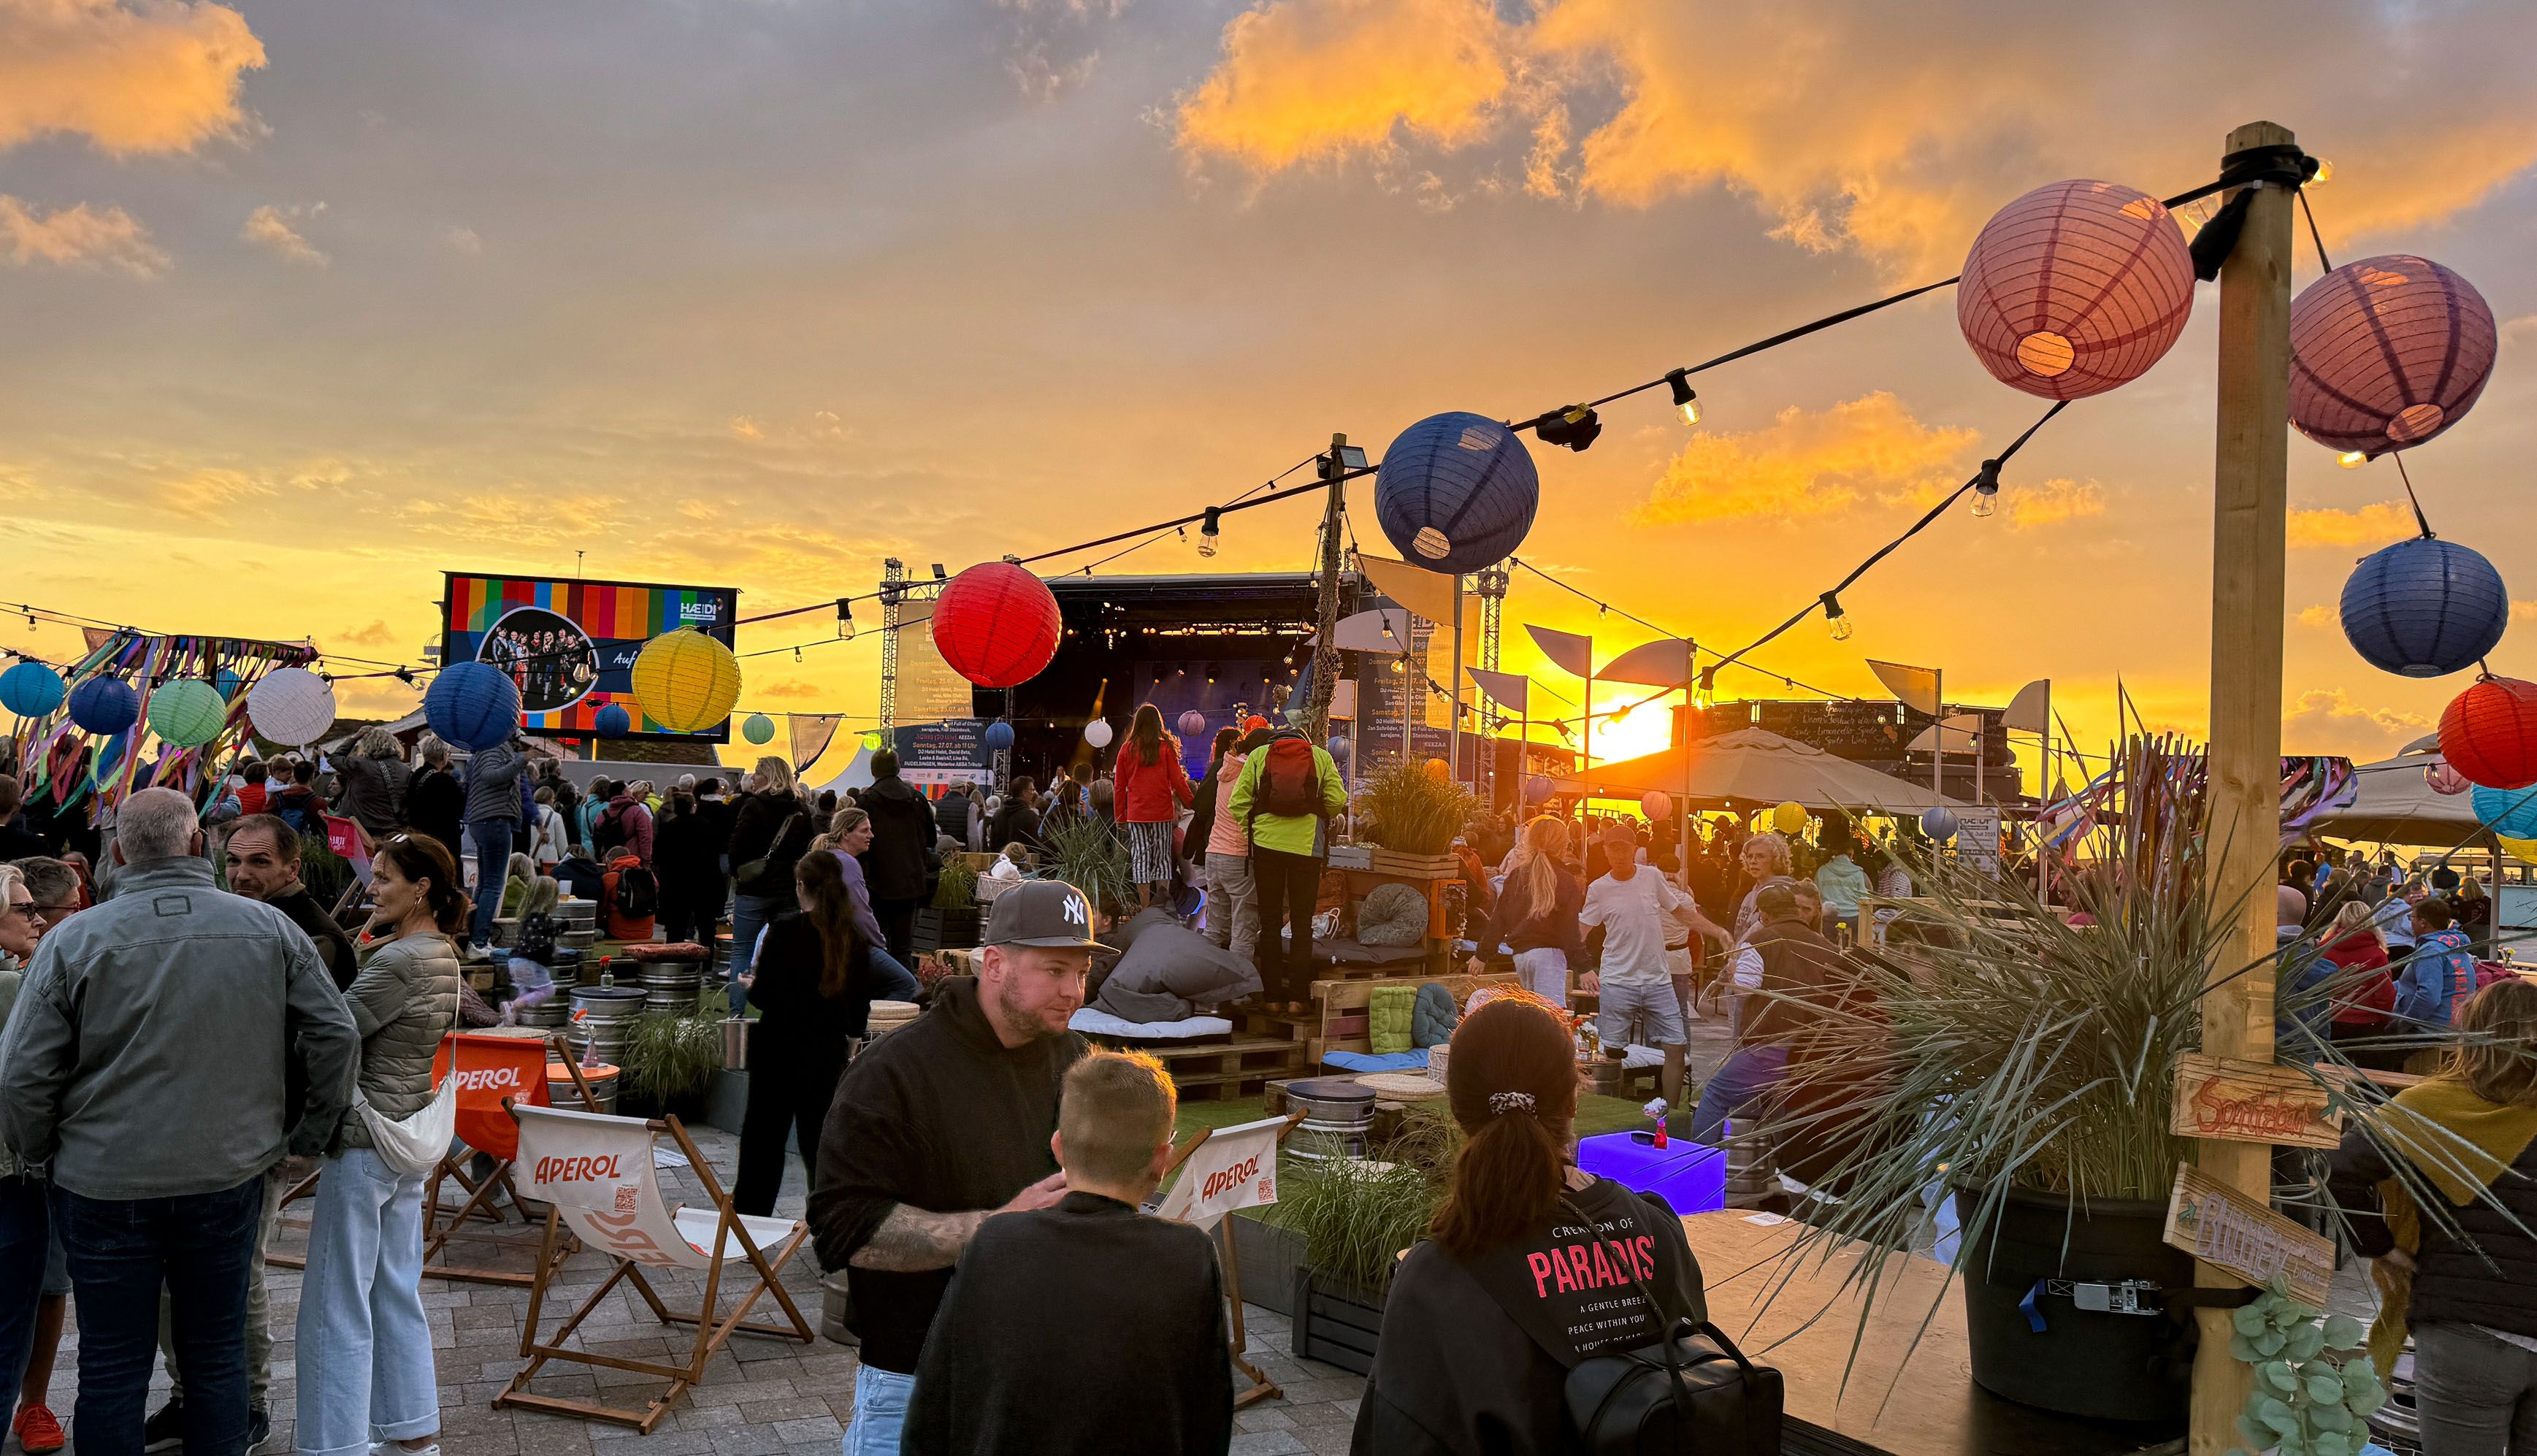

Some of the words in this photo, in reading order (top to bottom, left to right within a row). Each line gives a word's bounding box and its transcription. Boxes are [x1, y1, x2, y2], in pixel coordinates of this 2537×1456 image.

[613, 650, 638, 669] Auf
[535, 1154, 621, 1184] APEROL
[1202, 1154, 1259, 1203] APEROL
[1620, 1217, 1634, 1229] OF
[1580, 1305, 1585, 1314] A
[1588, 1300, 1619, 1312] GENTLE
[1568, 1322, 1594, 1336] PEACE
[1596, 1317, 1627, 1330] WITHIN
